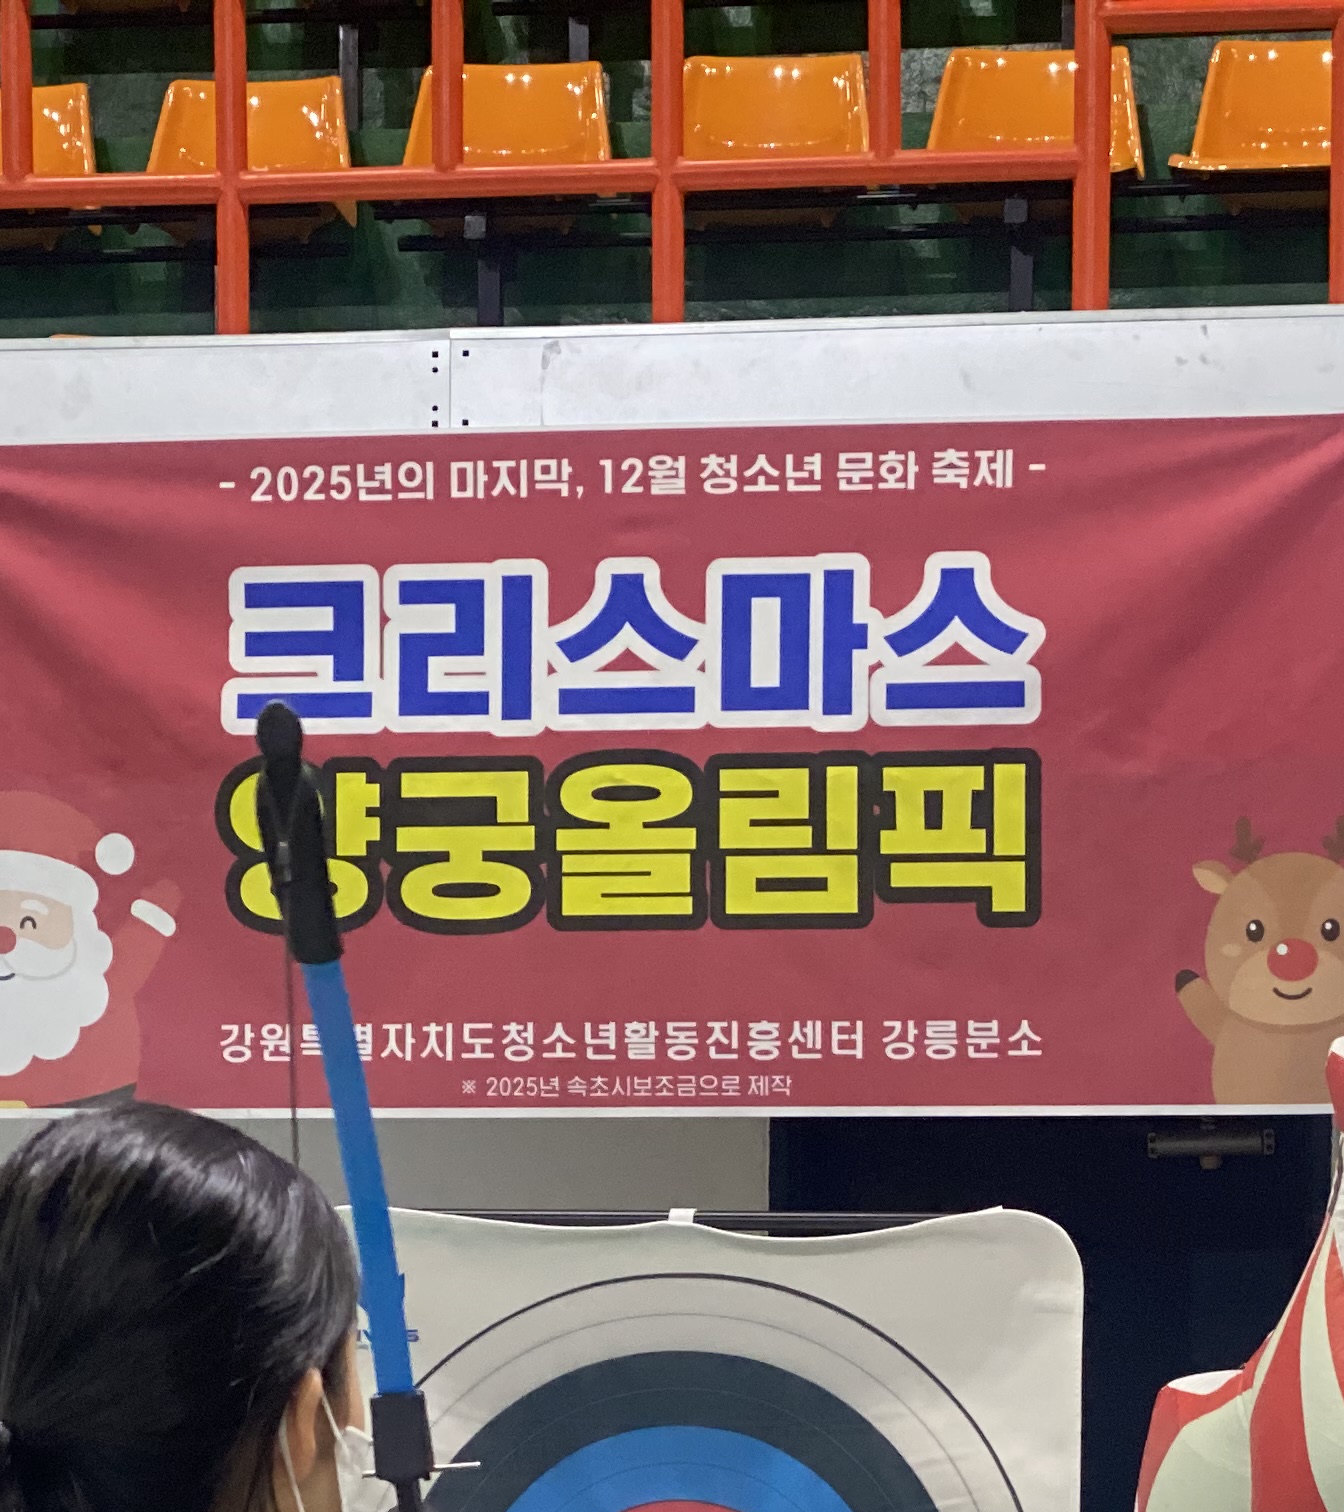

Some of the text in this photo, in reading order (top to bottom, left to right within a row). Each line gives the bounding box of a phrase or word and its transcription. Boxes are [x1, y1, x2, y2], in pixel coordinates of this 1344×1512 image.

[250, 461, 434, 502] 2025년의
[450, 458, 584, 499] 마지막,
[599, 453, 686, 495] 12월
[700, 453, 822, 495] 청소년
[837, 450, 919, 492] 문화
[932, 448, 1014, 489] 축제
[228, 558, 1038, 729] 크리스마스
[223, 756, 1033, 928] 양궁올림픽
[882, 1019, 1044, 1060] 강릉분소
[485, 1075, 560, 1097] 2025년
[567, 1075, 742, 1097] 속초시보조금으로
[747, 1074, 793, 1097] 제작
